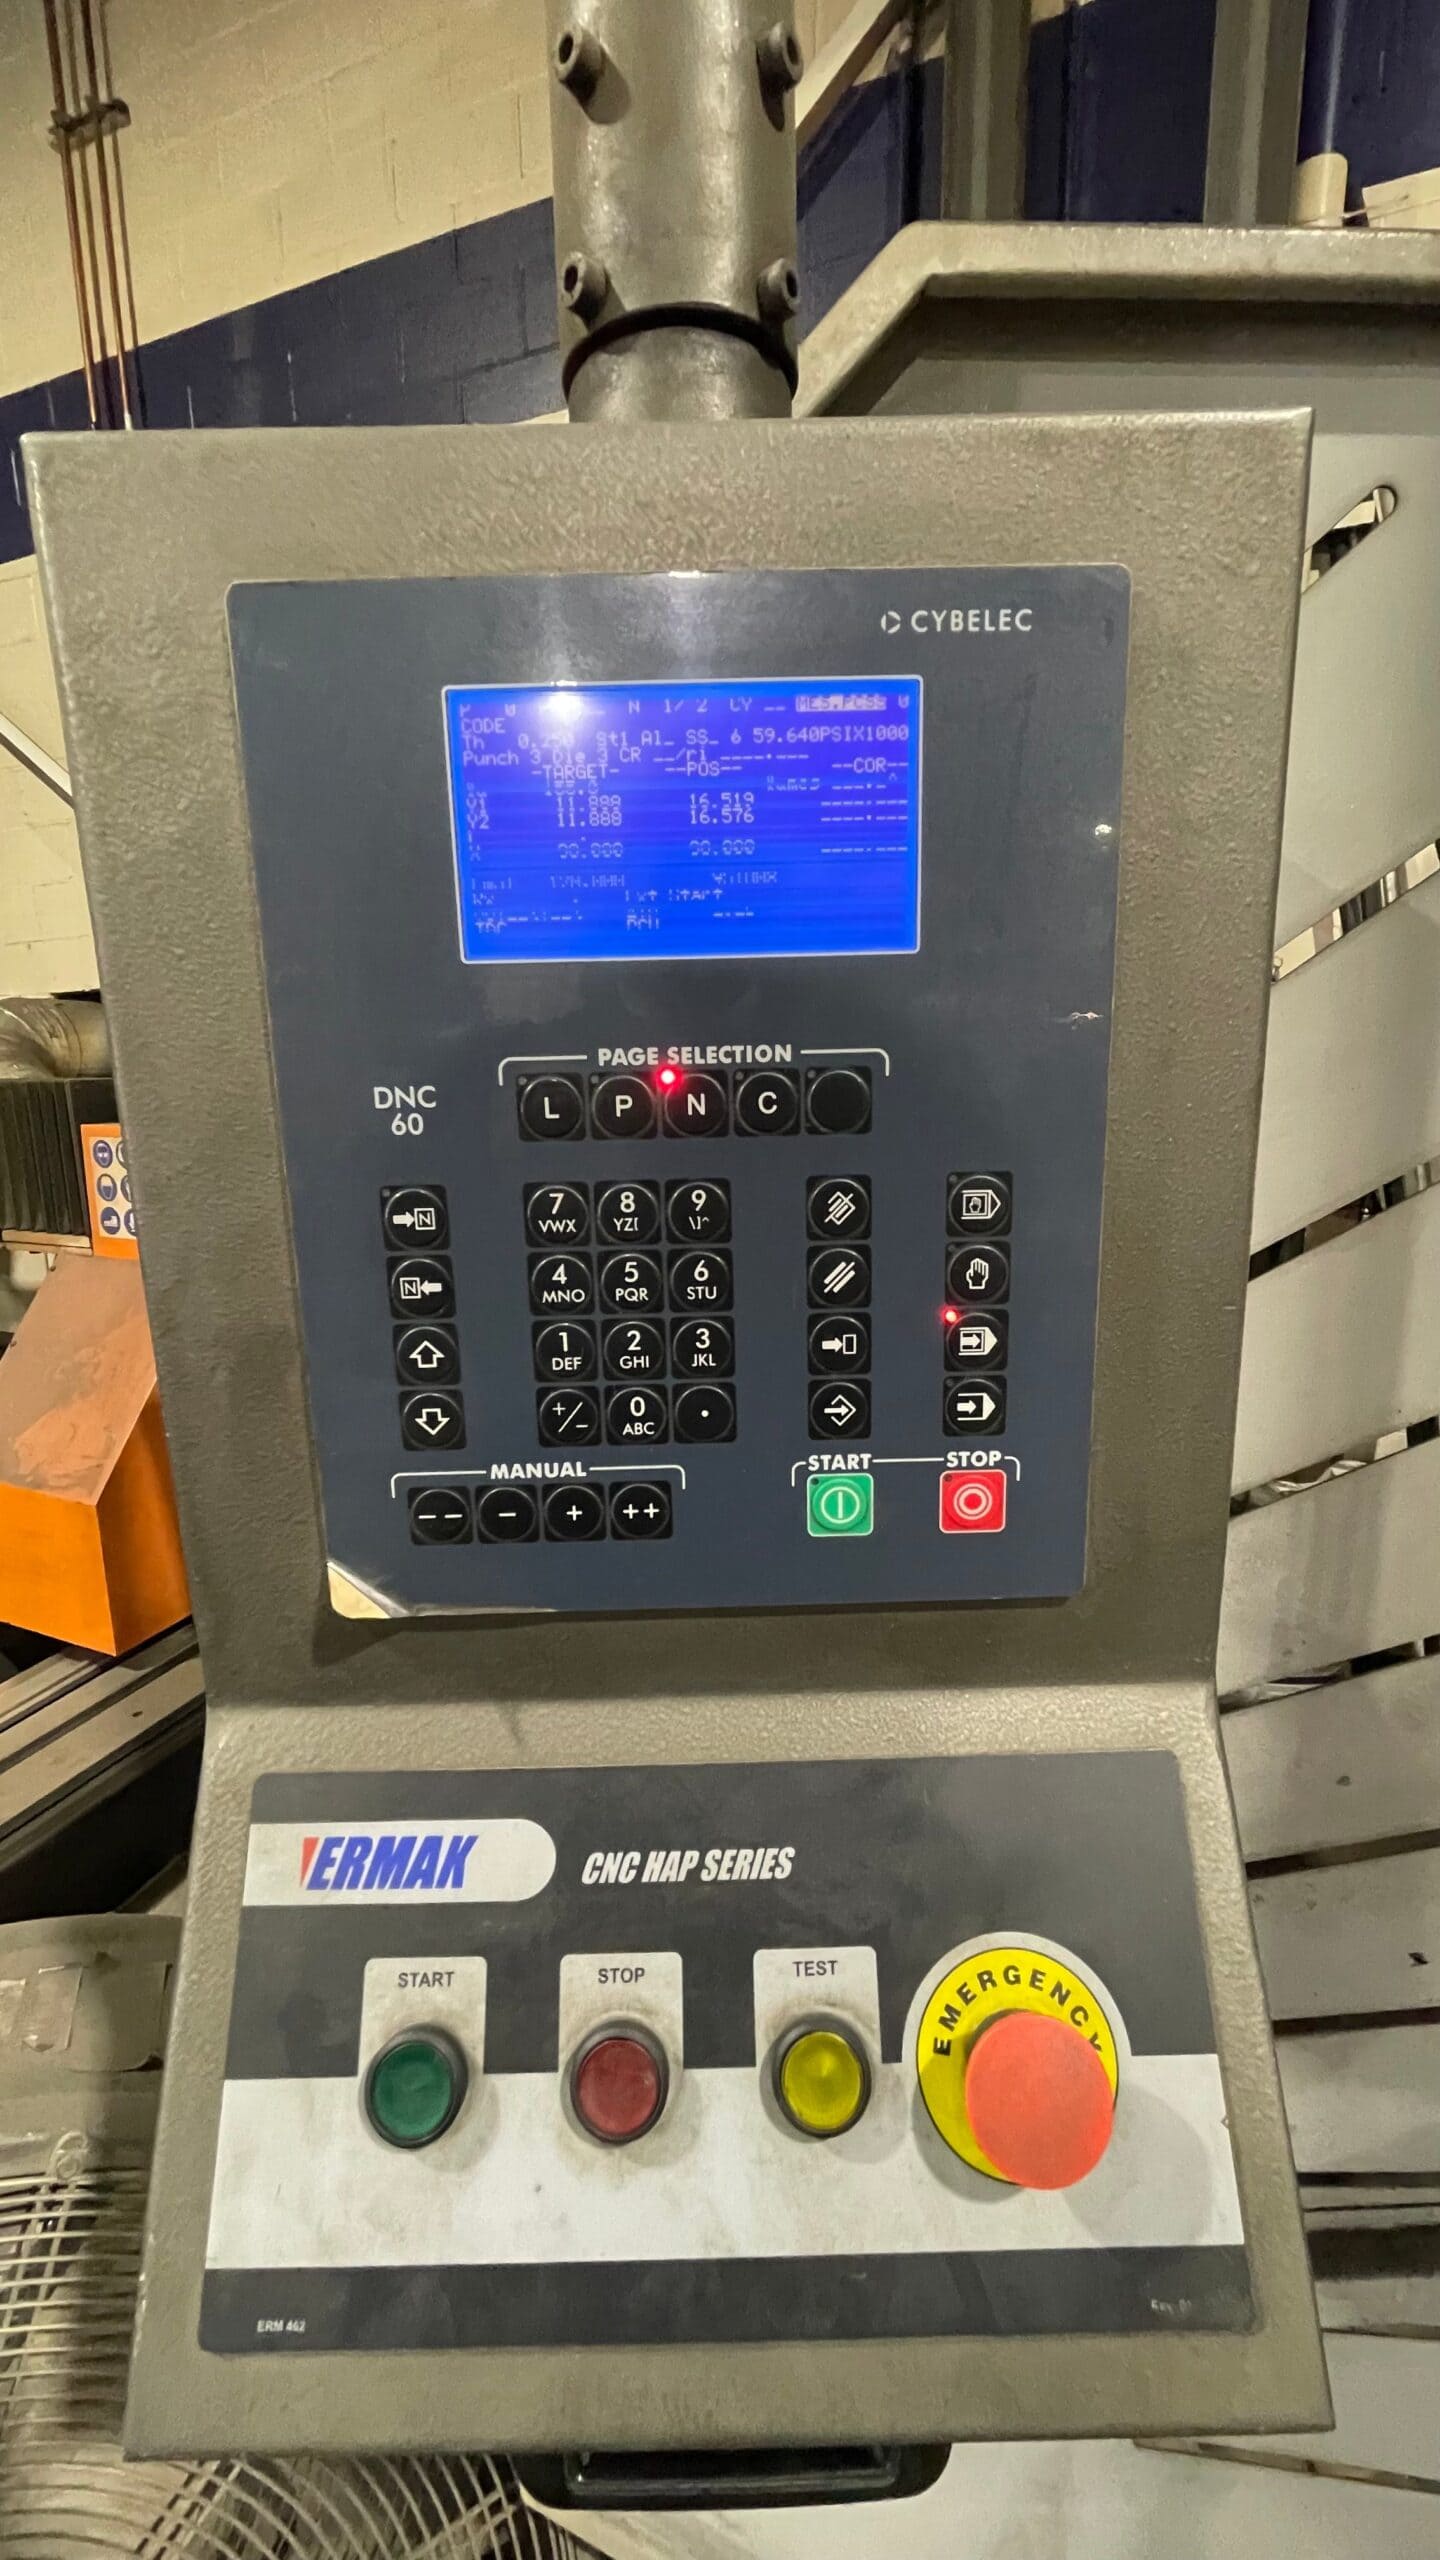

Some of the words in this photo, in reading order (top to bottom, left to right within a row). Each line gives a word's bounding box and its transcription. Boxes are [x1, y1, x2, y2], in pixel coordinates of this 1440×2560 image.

[911, 608, 1033, 633] CYBELEC
[461, 718, 506, 734] CODE
[463, 735, 485, 750] Th
[463, 750, 519, 767] Punch
[531, 748, 541, 765] 3
[619, 746, 641, 763] CR
[690, 809, 755, 825] 16.576
[597, 1048, 659, 1067] PAGE
[667, 1043, 793, 1066] SELECTION
[373, 1085, 437, 1109] DNC
[615, 1094, 634, 1119] P
[686, 1092, 706, 1117] N
[757, 1091, 778, 1116] C
[543, 1096, 560, 1120] L
[391, 1112, 424, 1136] 60
[549, 1192, 565, 1216] 7
[619, 1191, 636, 1214] 8
[691, 1189, 707, 1212] 9
[538, 1219, 577, 1233] VWX
[551, 1263, 568, 1285] 4
[624, 1261, 639, 1283] 5
[693, 1259, 709, 1282] 6
[542, 1288, 586, 1304] MNO
[615, 1287, 649, 1302] PQR
[686, 1285, 717, 1300] STU
[558, 1332, 569, 1352] 1
[626, 1330, 642, 1351] 2
[695, 1328, 710, 1350] 3
[552, 1357, 582, 1371] DEF
[619, 1355, 650, 1370] GHI
[691, 1354, 717, 1368] JKL
[629, 1396, 645, 1417] 0
[622, 1422, 655, 1436] ABC
[808, 1453, 872, 1471] START
[946, 1450, 1002, 1468] STOP
[490, 1461, 587, 1480] MANUAL
[306, 1835, 479, 1890] ERMAK
[581, 1851, 642, 1885] CNC
[641, 1850, 700, 1883] HAP
[700, 1846, 796, 1882] SERIES
[598, 1967, 645, 1984] STOP
[792, 1960, 838, 1977] TEST
[398, 1971, 455, 1988] START
[257, 2319, 284, 2332] ERM
